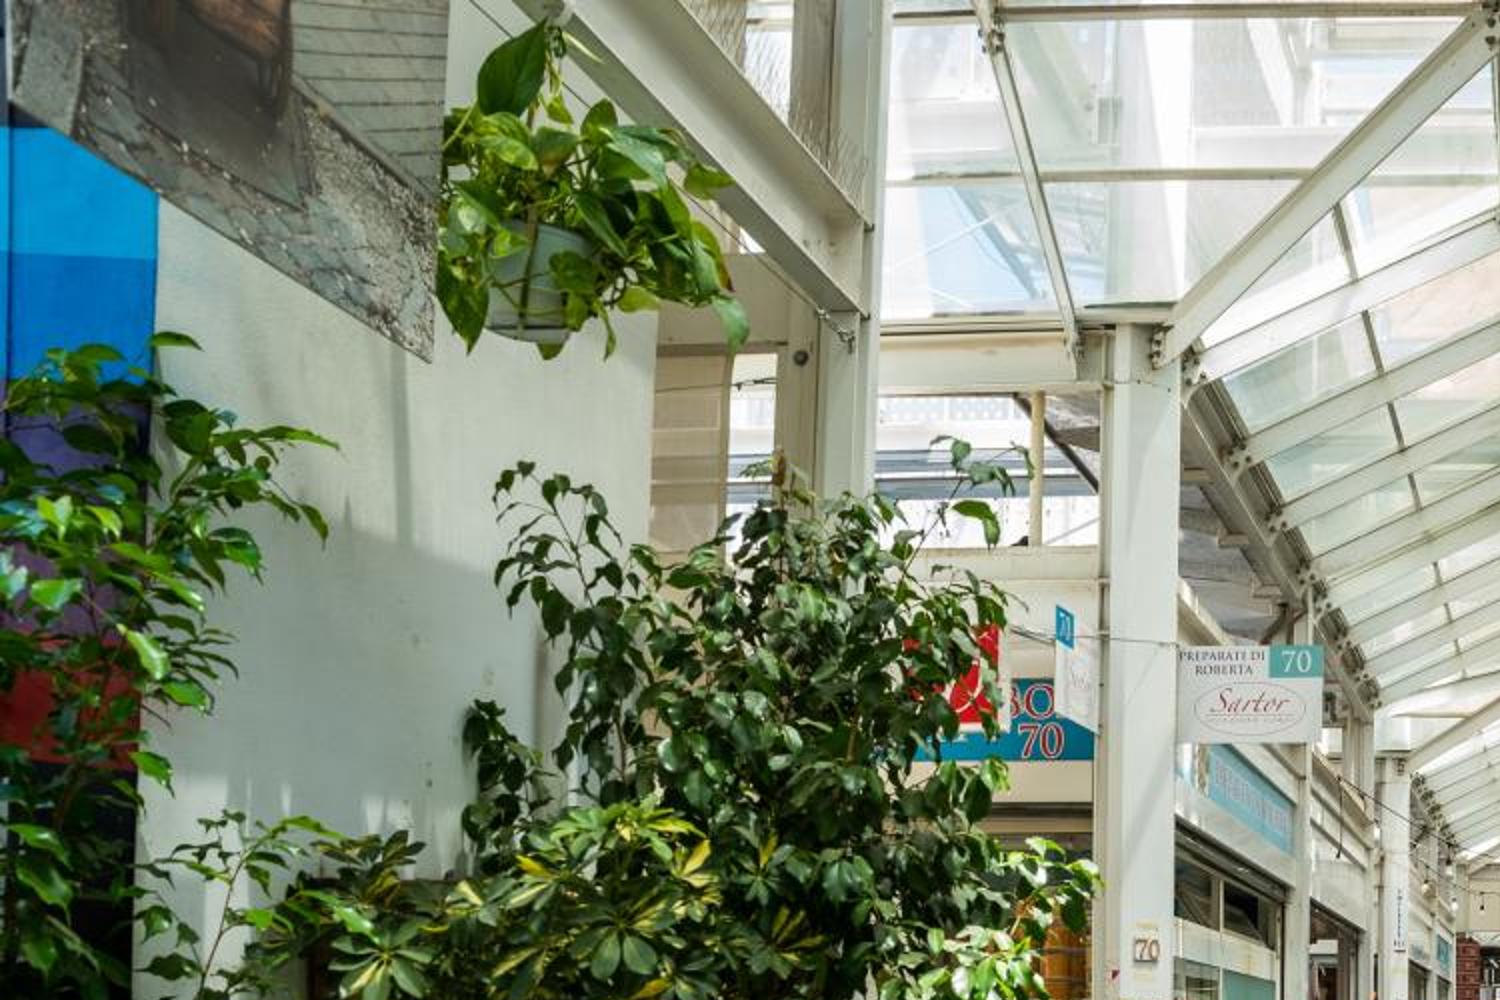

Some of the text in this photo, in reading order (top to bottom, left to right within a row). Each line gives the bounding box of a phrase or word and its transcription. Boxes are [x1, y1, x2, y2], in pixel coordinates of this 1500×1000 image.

[1251, 651, 1265, 661] DI
[1281, 650, 1313, 673] 70
[1194, 664, 1254, 677] ROBERTA
[1209, 687, 1291, 717] Sartor
[1018, 722, 1065, 760] 70
[1134, 937, 1161, 963] 70
